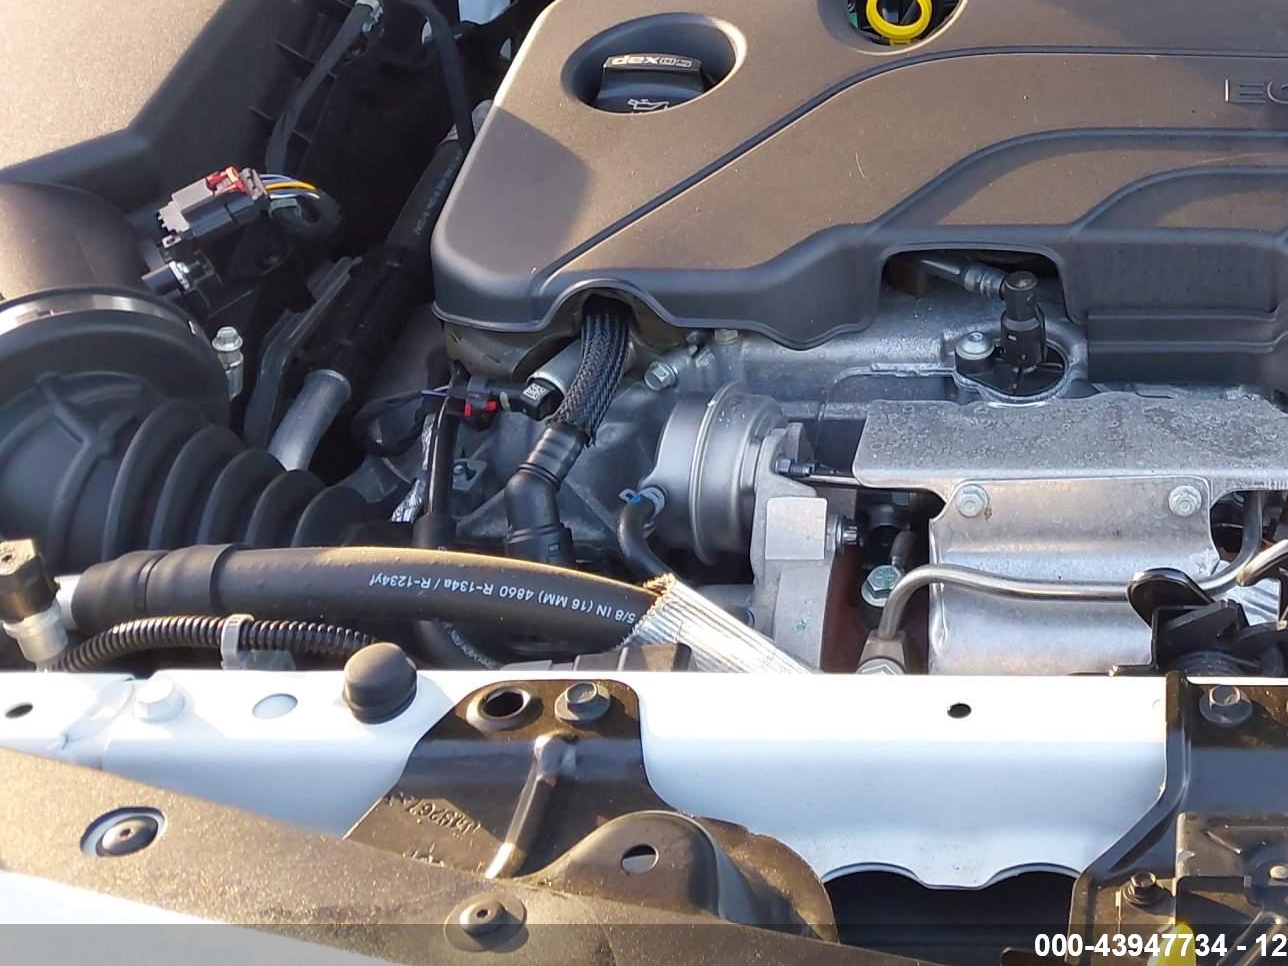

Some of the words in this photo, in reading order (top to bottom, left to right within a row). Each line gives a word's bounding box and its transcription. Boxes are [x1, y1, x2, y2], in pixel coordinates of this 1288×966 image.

[611, 55, 693, 68] dexos
[368, 572, 431, 590] R-1234yf
[443, 578, 494, 595] R-134a
[499, 585, 534, 600] 4860
[537, 590, 568, 608] MM)
[571, 598, 594, 613] (16
[595, 603, 612, 618] IN
[615, 609, 636, 624] 5/8
